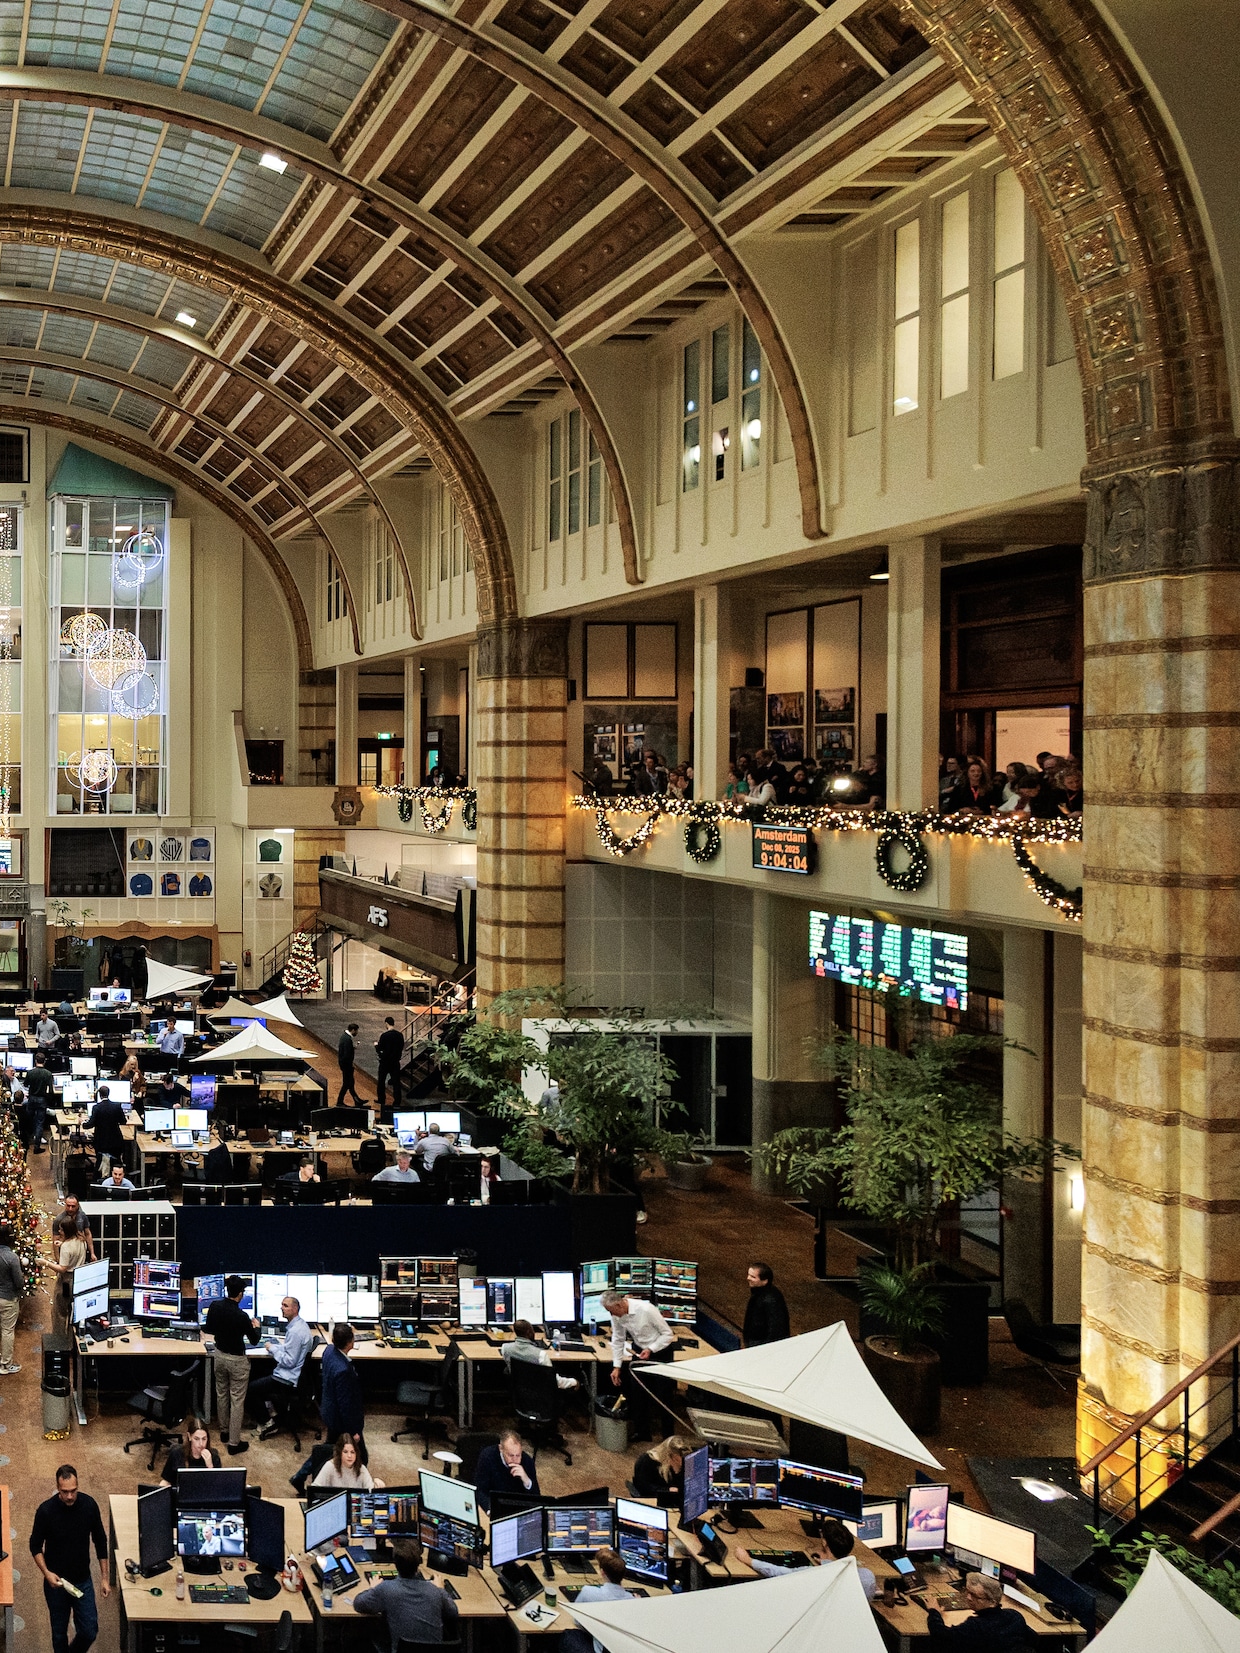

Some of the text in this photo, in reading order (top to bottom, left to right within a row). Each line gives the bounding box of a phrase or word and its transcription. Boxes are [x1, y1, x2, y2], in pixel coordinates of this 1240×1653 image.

[755, 828, 807, 843] Amsterdam
[761, 842, 773, 852] Dec
[785, 844, 800, 854] 2025
[760, 851, 808, 870] 9:04:04
[824, 960, 840, 972] RELX
